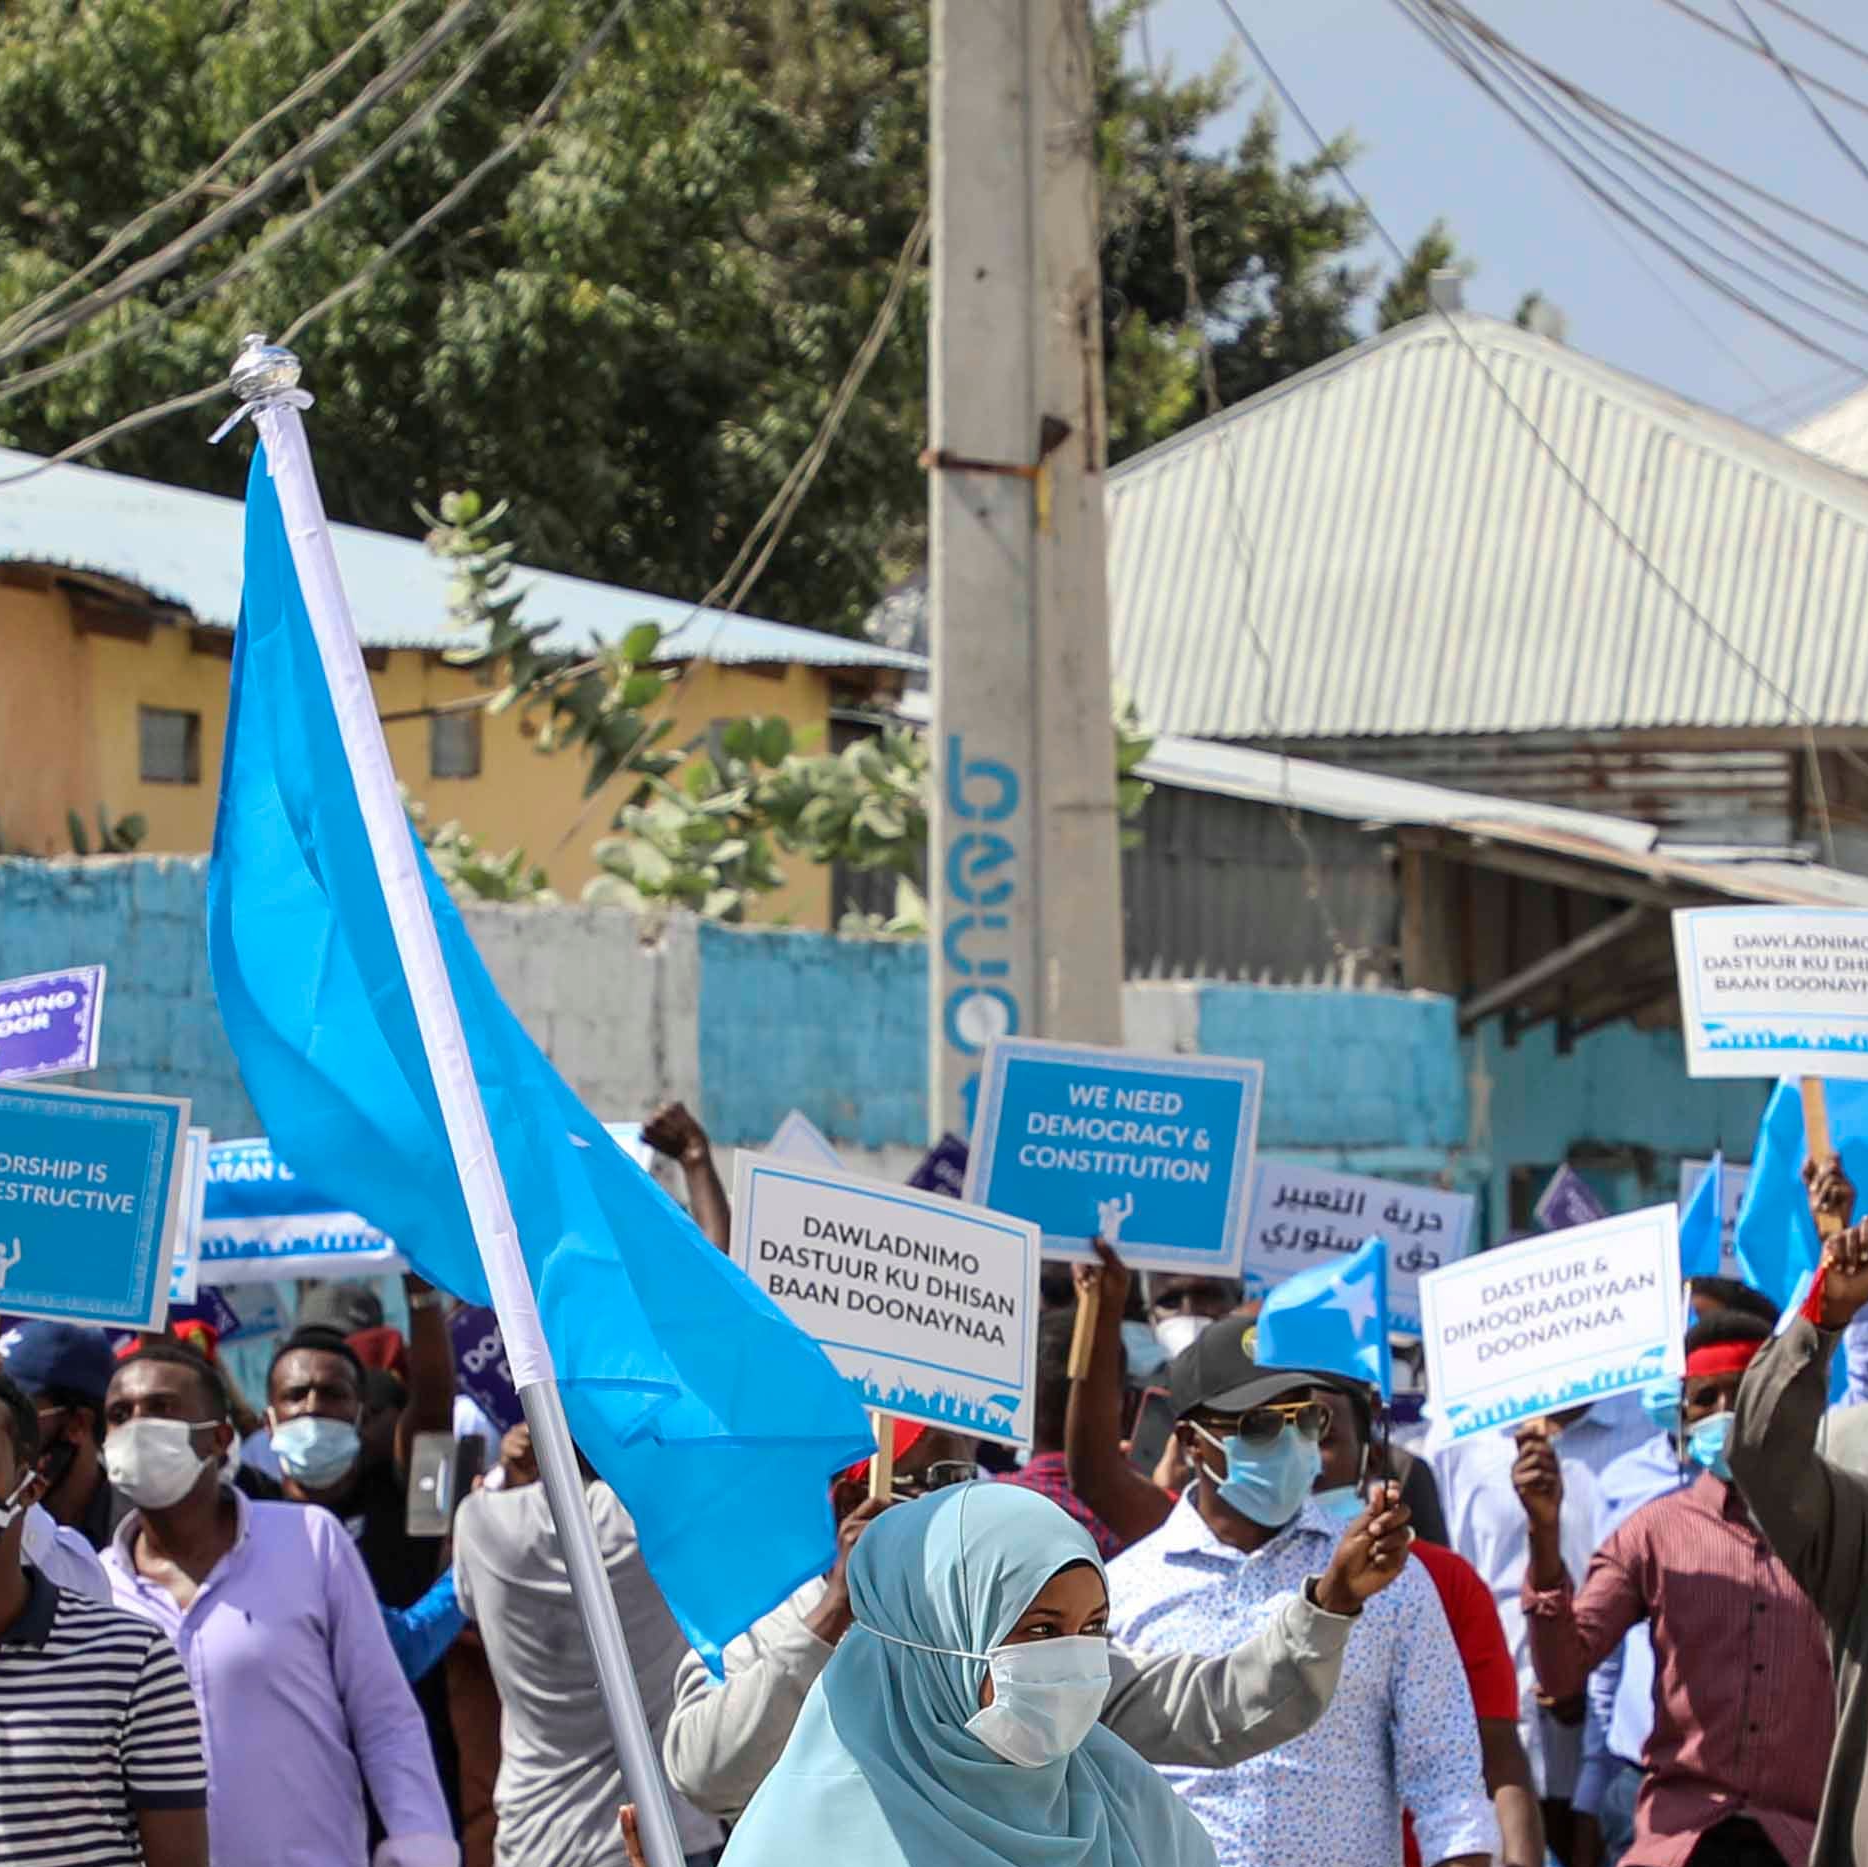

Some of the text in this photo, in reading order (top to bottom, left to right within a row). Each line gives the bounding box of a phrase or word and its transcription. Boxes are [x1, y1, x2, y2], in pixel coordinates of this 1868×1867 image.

[1703, 955, 1796, 971] DASTUUR
[1801, 956, 1829, 971] KU
[1714, 975, 1769, 991] BAAN
[1068, 1083, 1184, 1117] WE NEED
[1026, 1111, 1212, 1152] DEMOCRACY &
[87, 1162, 108, 1184] IS
[1018, 1143, 1211, 1185] CONSTITUTION
[1272, 1183, 1443, 1235] حرية التعبير
[803, 1215, 981, 1276] DAWLADNIMO
[1260, 1221, 1364, 1255] ستوري
[760, 1239, 1015, 1318] DASTUUR KU DHISAN
[1481, 1256, 1609, 1306] DASTUUR &
[768, 1273, 1006, 1348] BAAN DOONAYNAA
[1443, 1270, 1656, 1345] DIMOQRAADIYAAN
[1477, 1304, 1625, 1363] DOONAYNAA
